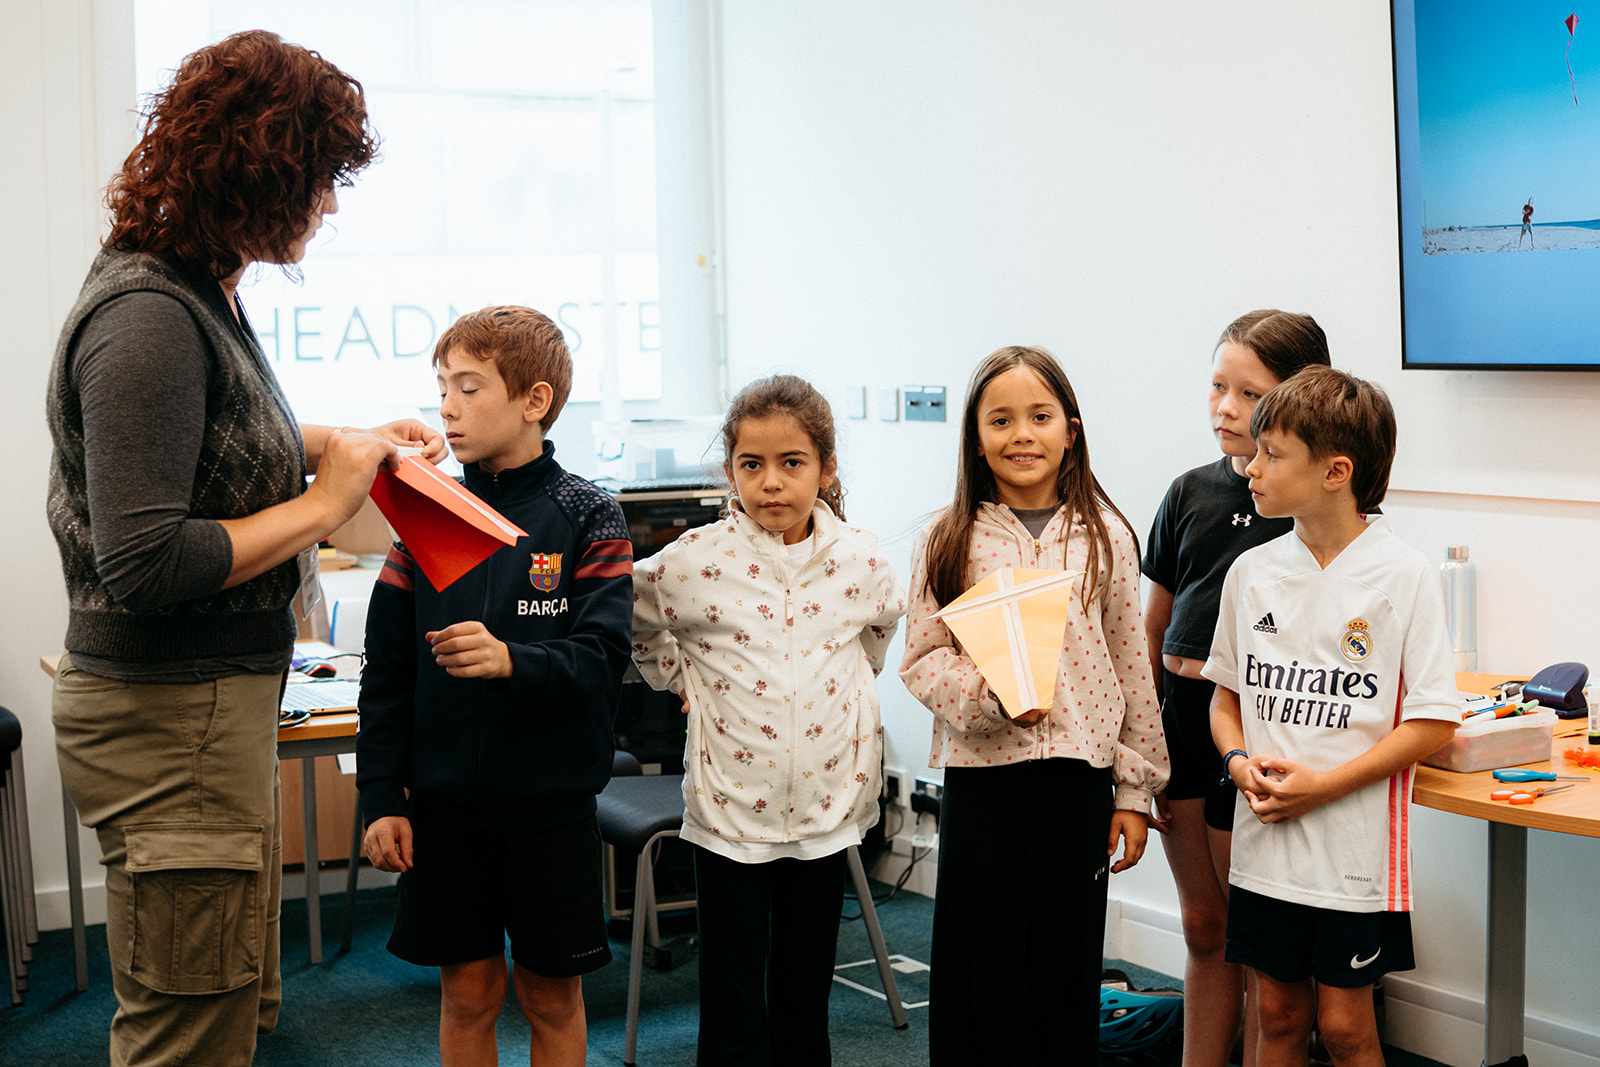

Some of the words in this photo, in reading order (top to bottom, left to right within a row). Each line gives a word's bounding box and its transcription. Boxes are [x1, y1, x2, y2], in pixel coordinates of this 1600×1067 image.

[517, 598, 569, 617] BARÇA
[1253, 624, 1278, 634] adidas
[1246, 653, 1378, 699] Emirates
[1256, 694, 1277, 721] FLY
[1280, 698, 1352, 729] BETTER
